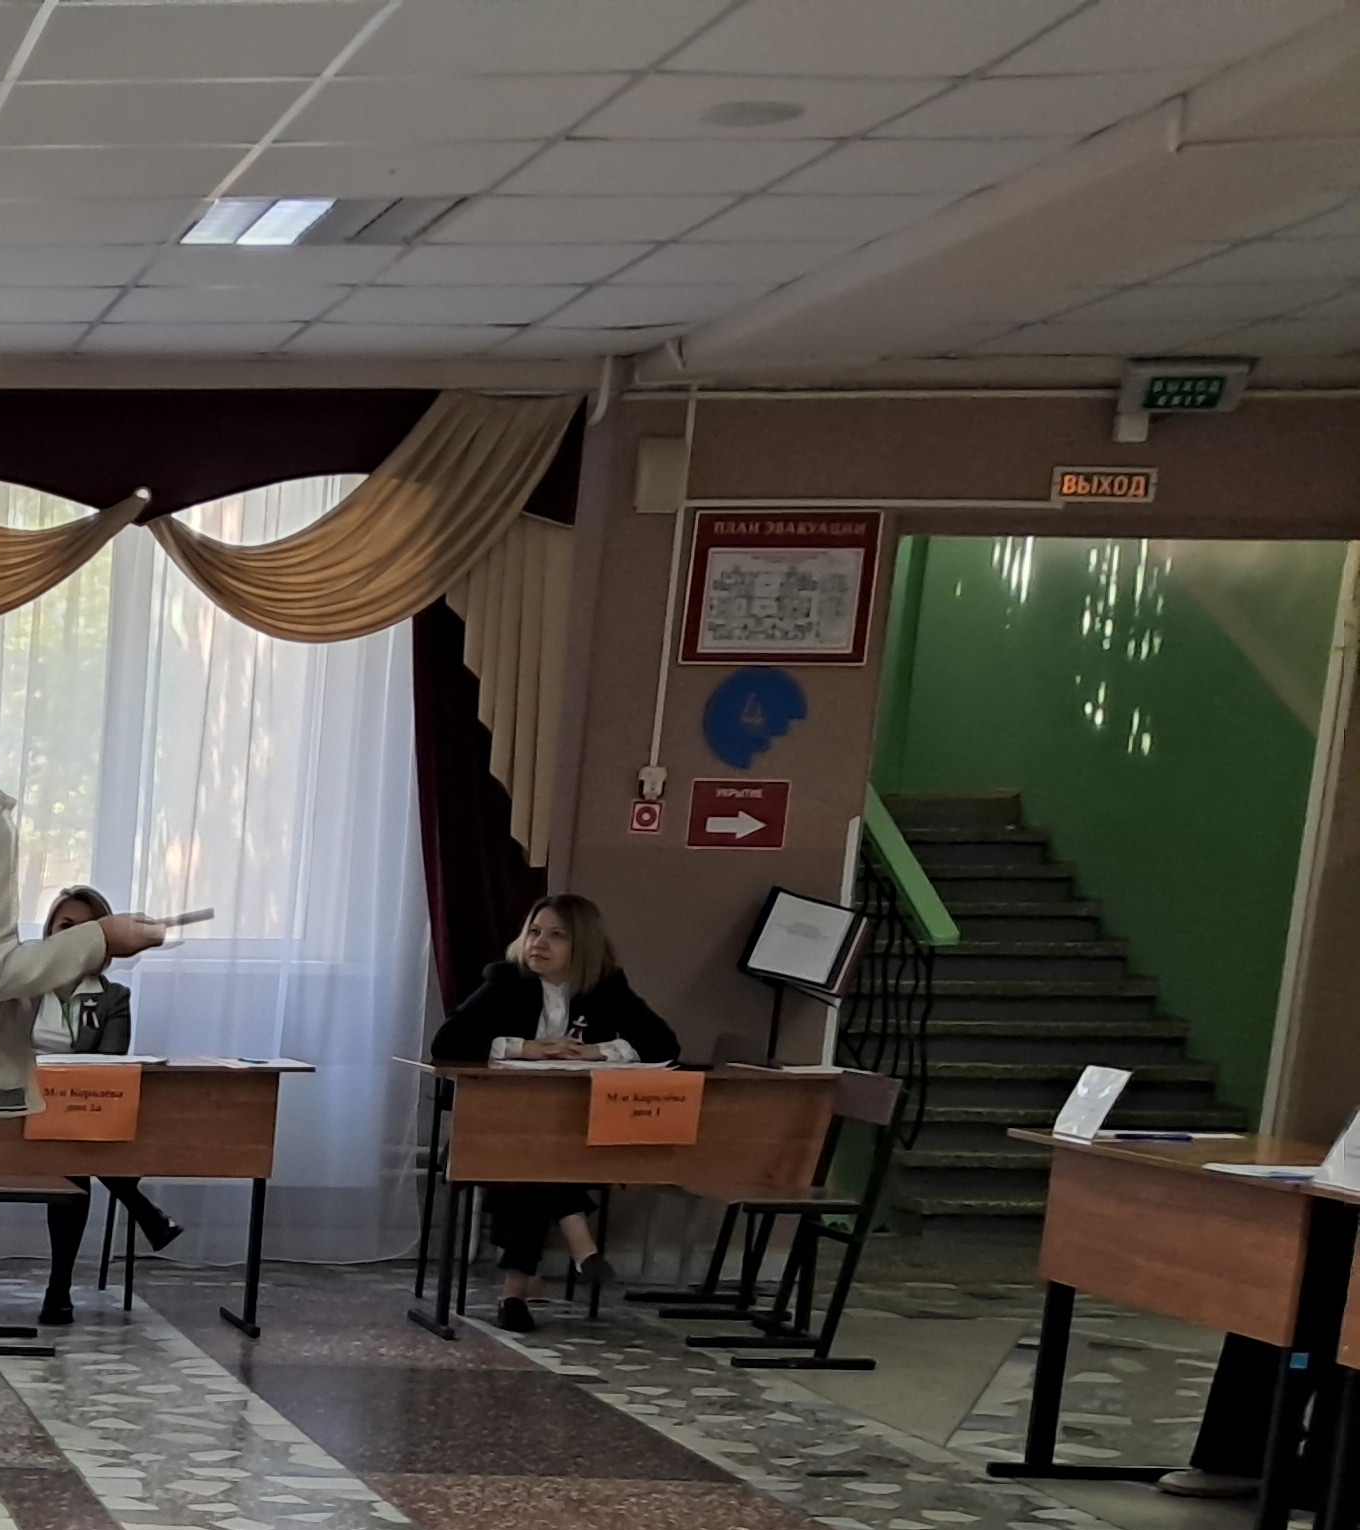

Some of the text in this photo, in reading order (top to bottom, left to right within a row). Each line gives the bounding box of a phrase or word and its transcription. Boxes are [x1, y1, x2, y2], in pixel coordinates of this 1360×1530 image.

[1061, 474, 1146, 497] ВЫХОД
[713, 521, 867, 536] ПЛАН ЭВАКУАЦИИ
